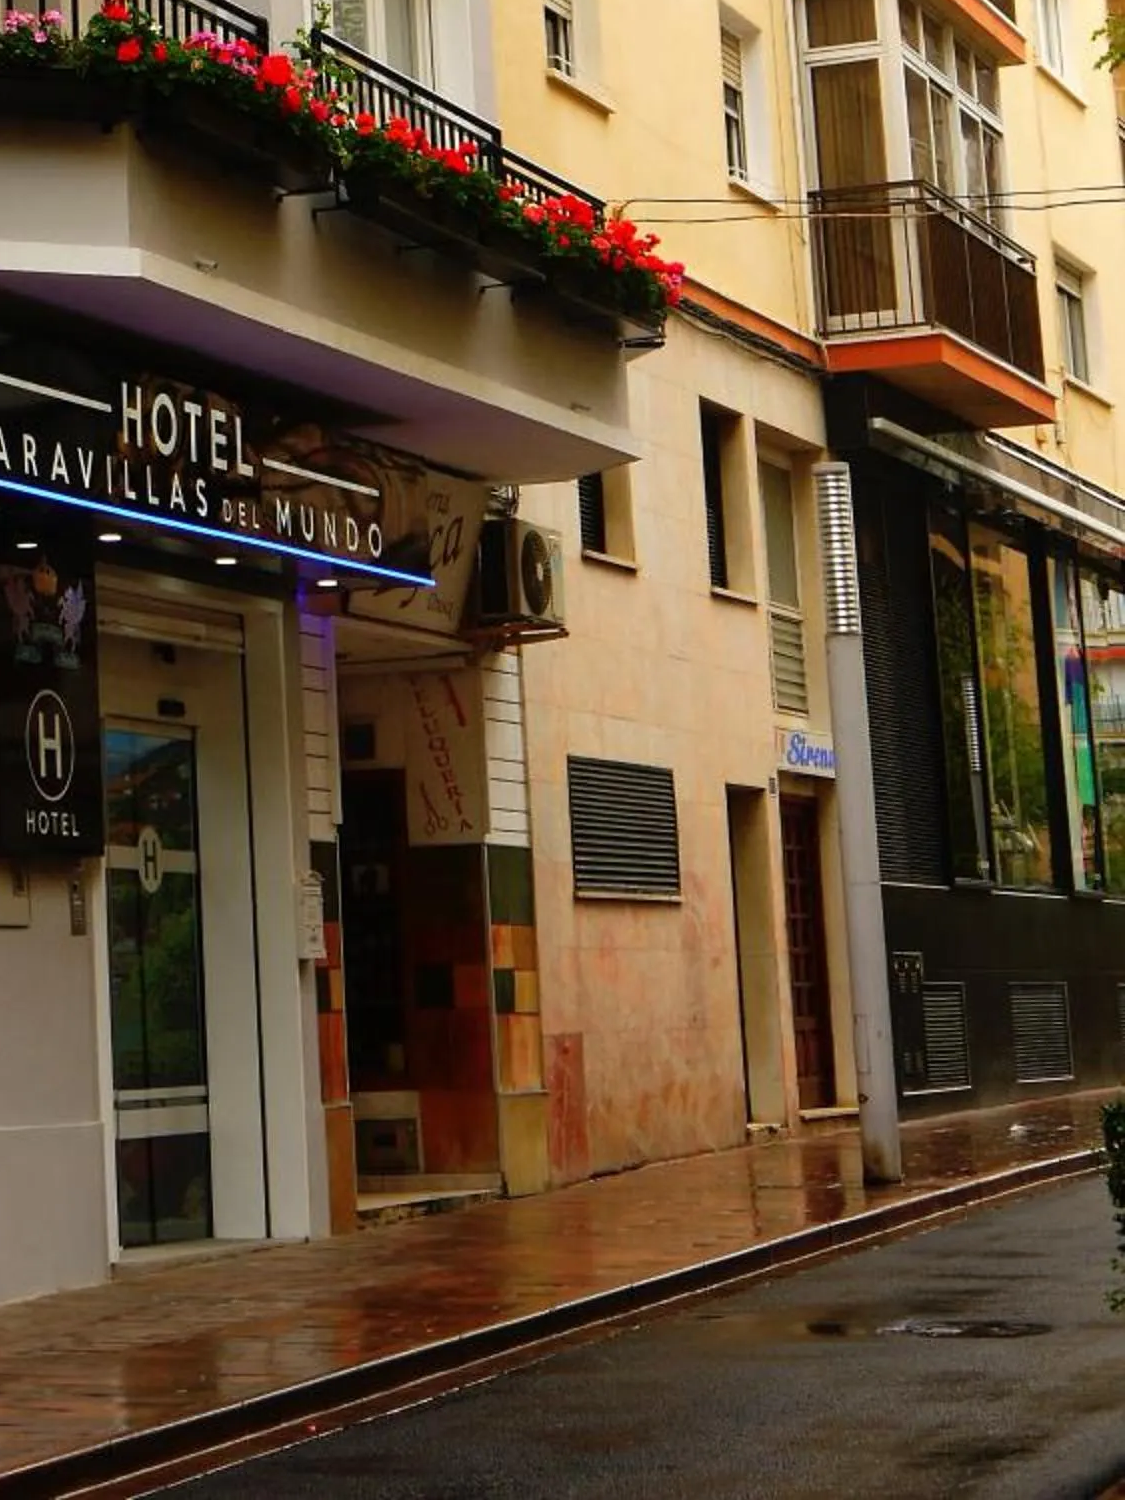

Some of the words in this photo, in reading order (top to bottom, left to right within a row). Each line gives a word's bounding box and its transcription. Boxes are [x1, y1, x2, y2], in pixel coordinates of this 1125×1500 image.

[122, 381, 254, 477] HOTEL
[222, 497, 261, 531] DEL
[276, 497, 382, 558] MUNDO
[38, 712, 63, 779] H
[26, 809, 81, 837] HOTEL
[143, 838, 159, 882] H
